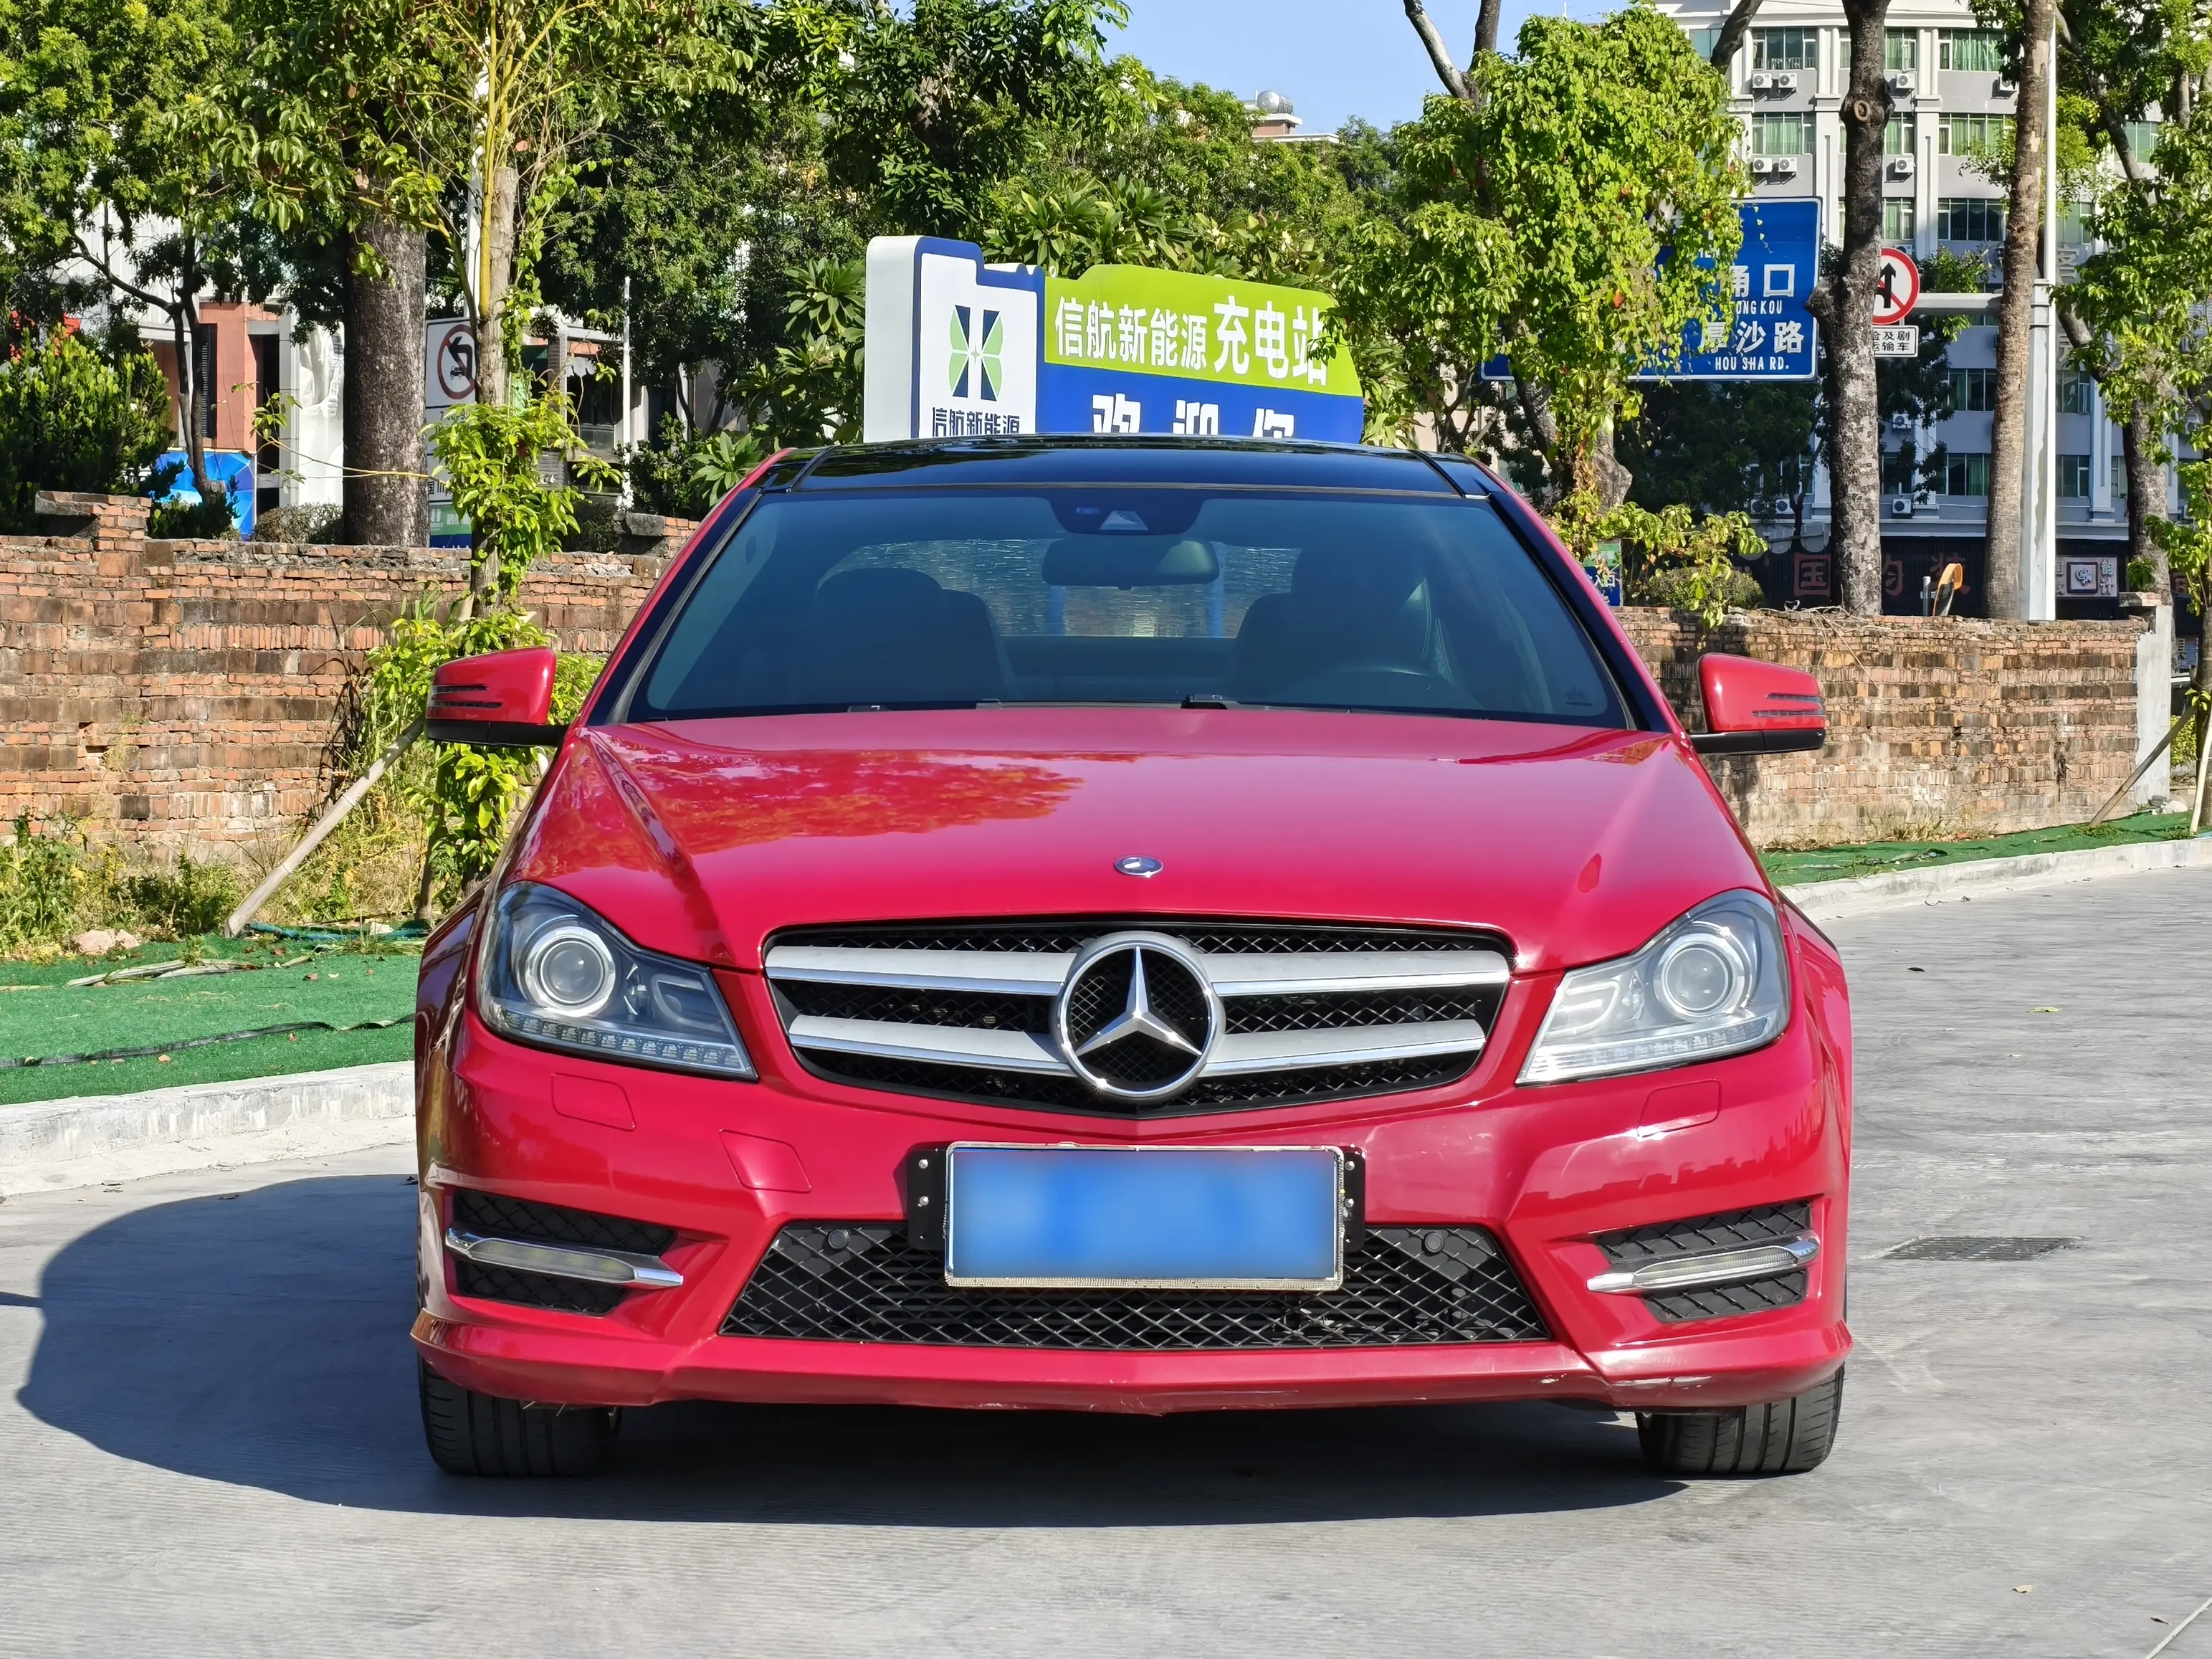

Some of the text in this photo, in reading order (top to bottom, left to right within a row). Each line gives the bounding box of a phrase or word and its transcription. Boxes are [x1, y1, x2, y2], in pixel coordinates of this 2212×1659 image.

[1735, 300, 1783, 314] ONG KOU
[1055, 295, 1327, 386] 信航新能源充电站
[1872, 342, 1910, 351] 运输车
[1715, 356, 1789, 371] HOU SHA RD.
[1588, 574, 1616, 588] 入口
